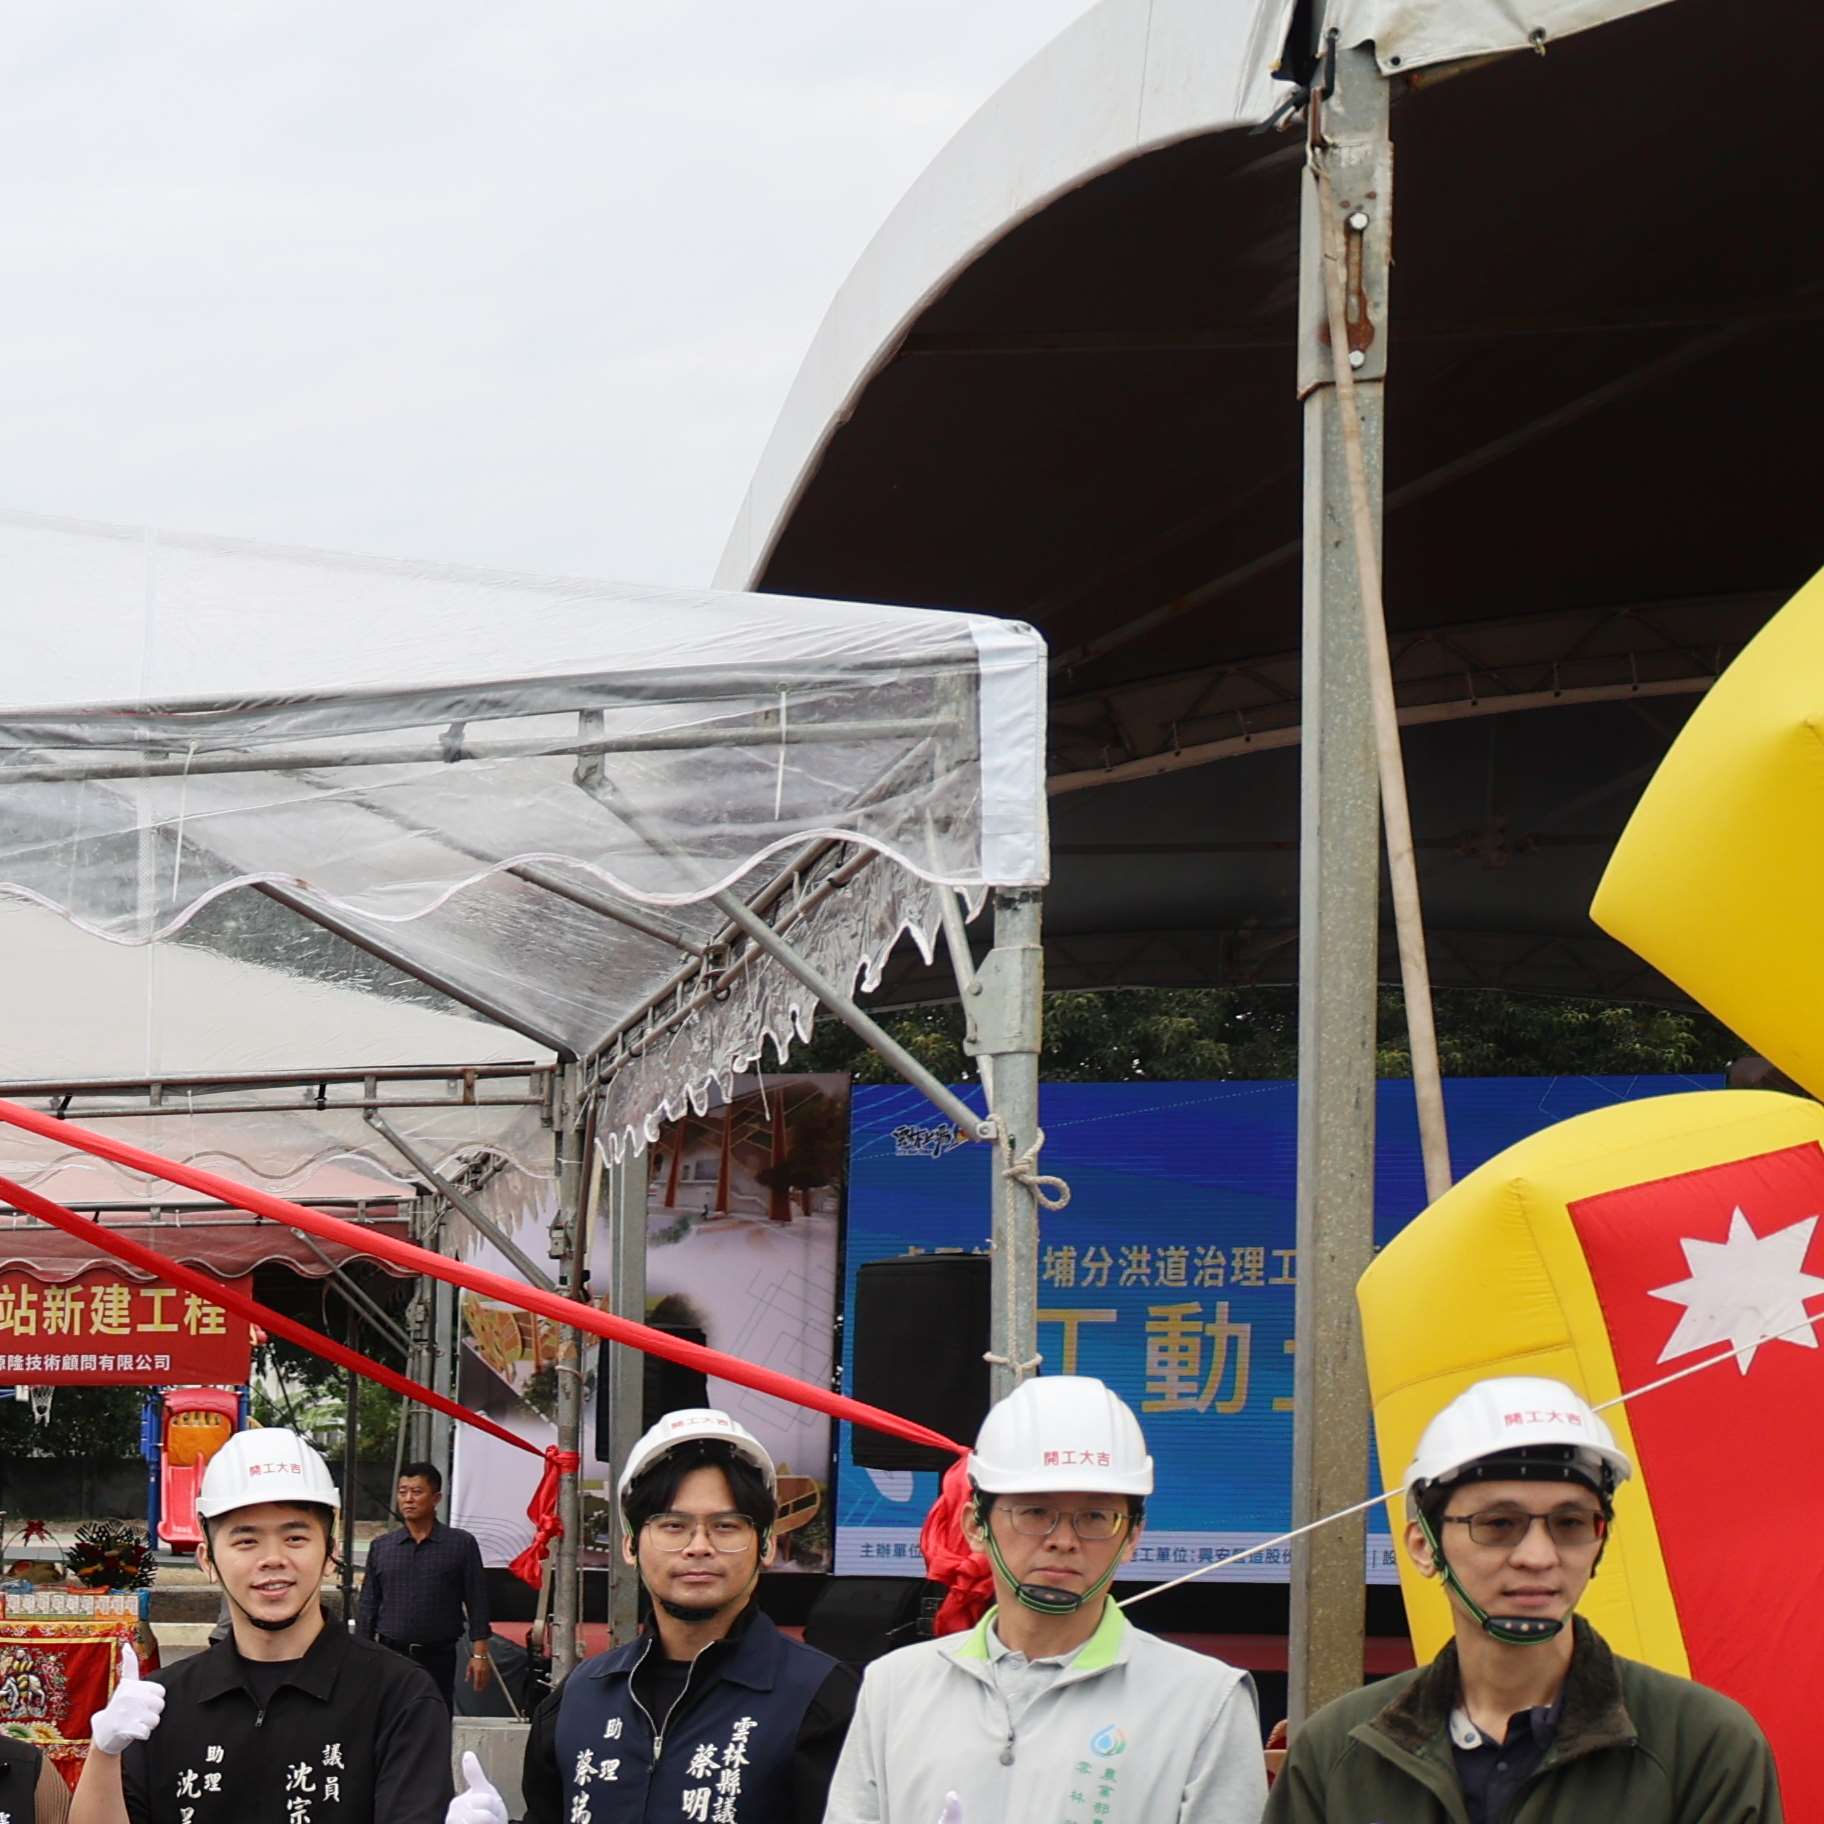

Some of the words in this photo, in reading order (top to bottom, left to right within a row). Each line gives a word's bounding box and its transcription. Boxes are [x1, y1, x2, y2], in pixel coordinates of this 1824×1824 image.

[203, 1745, 224, 1792] 助理
[322, 1743, 345, 1803] 議員
[598, 1717, 623, 1781] 助理
